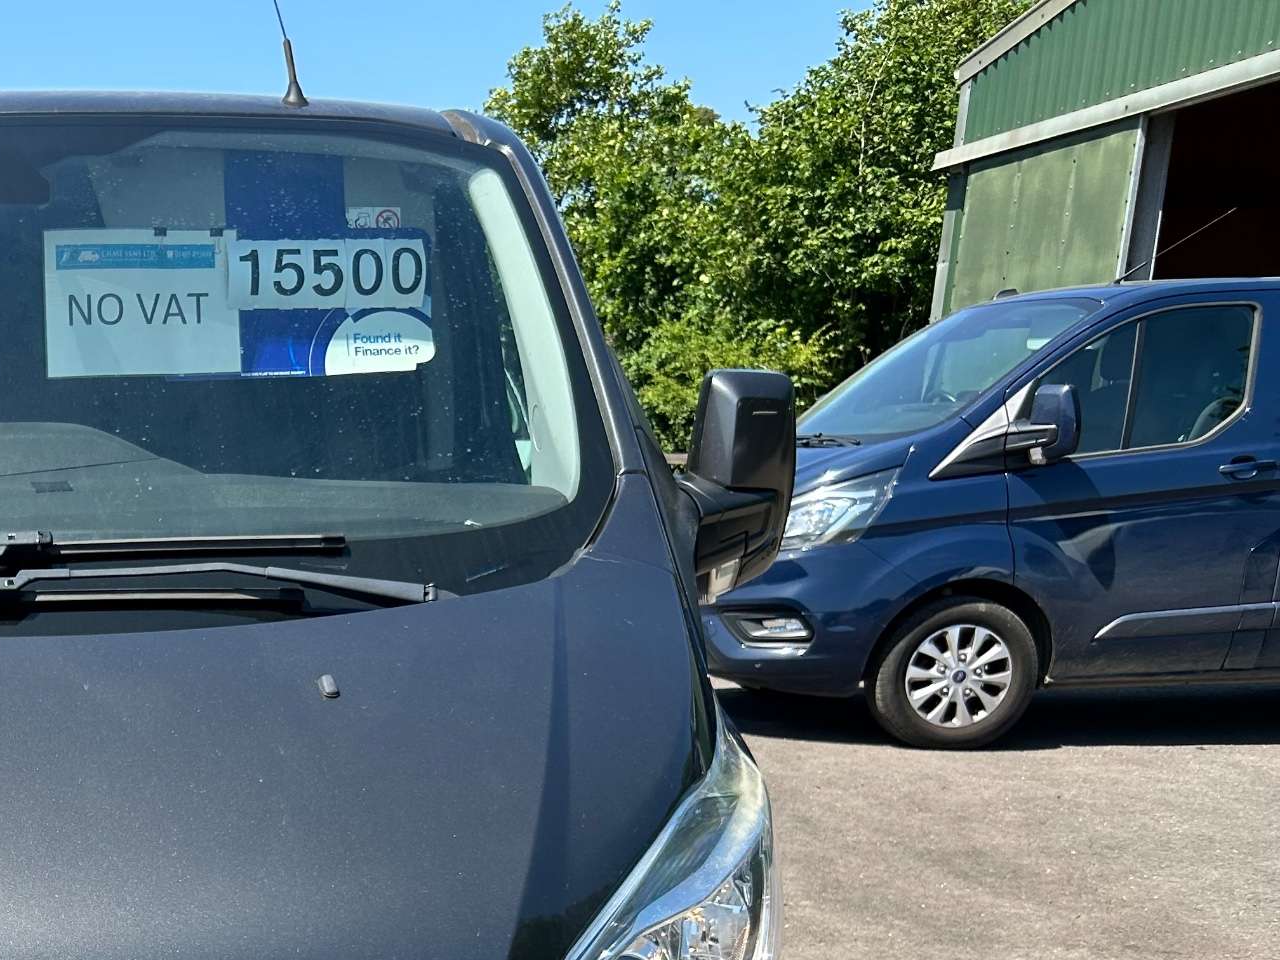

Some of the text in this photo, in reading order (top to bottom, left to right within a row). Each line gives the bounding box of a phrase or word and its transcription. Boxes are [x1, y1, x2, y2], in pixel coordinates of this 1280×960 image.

[238, 247, 423, 298] 15500
[68, 292, 209, 326] NO VAT
[352, 333, 403, 344] Found it
[354, 344, 420, 357] Finance it?
